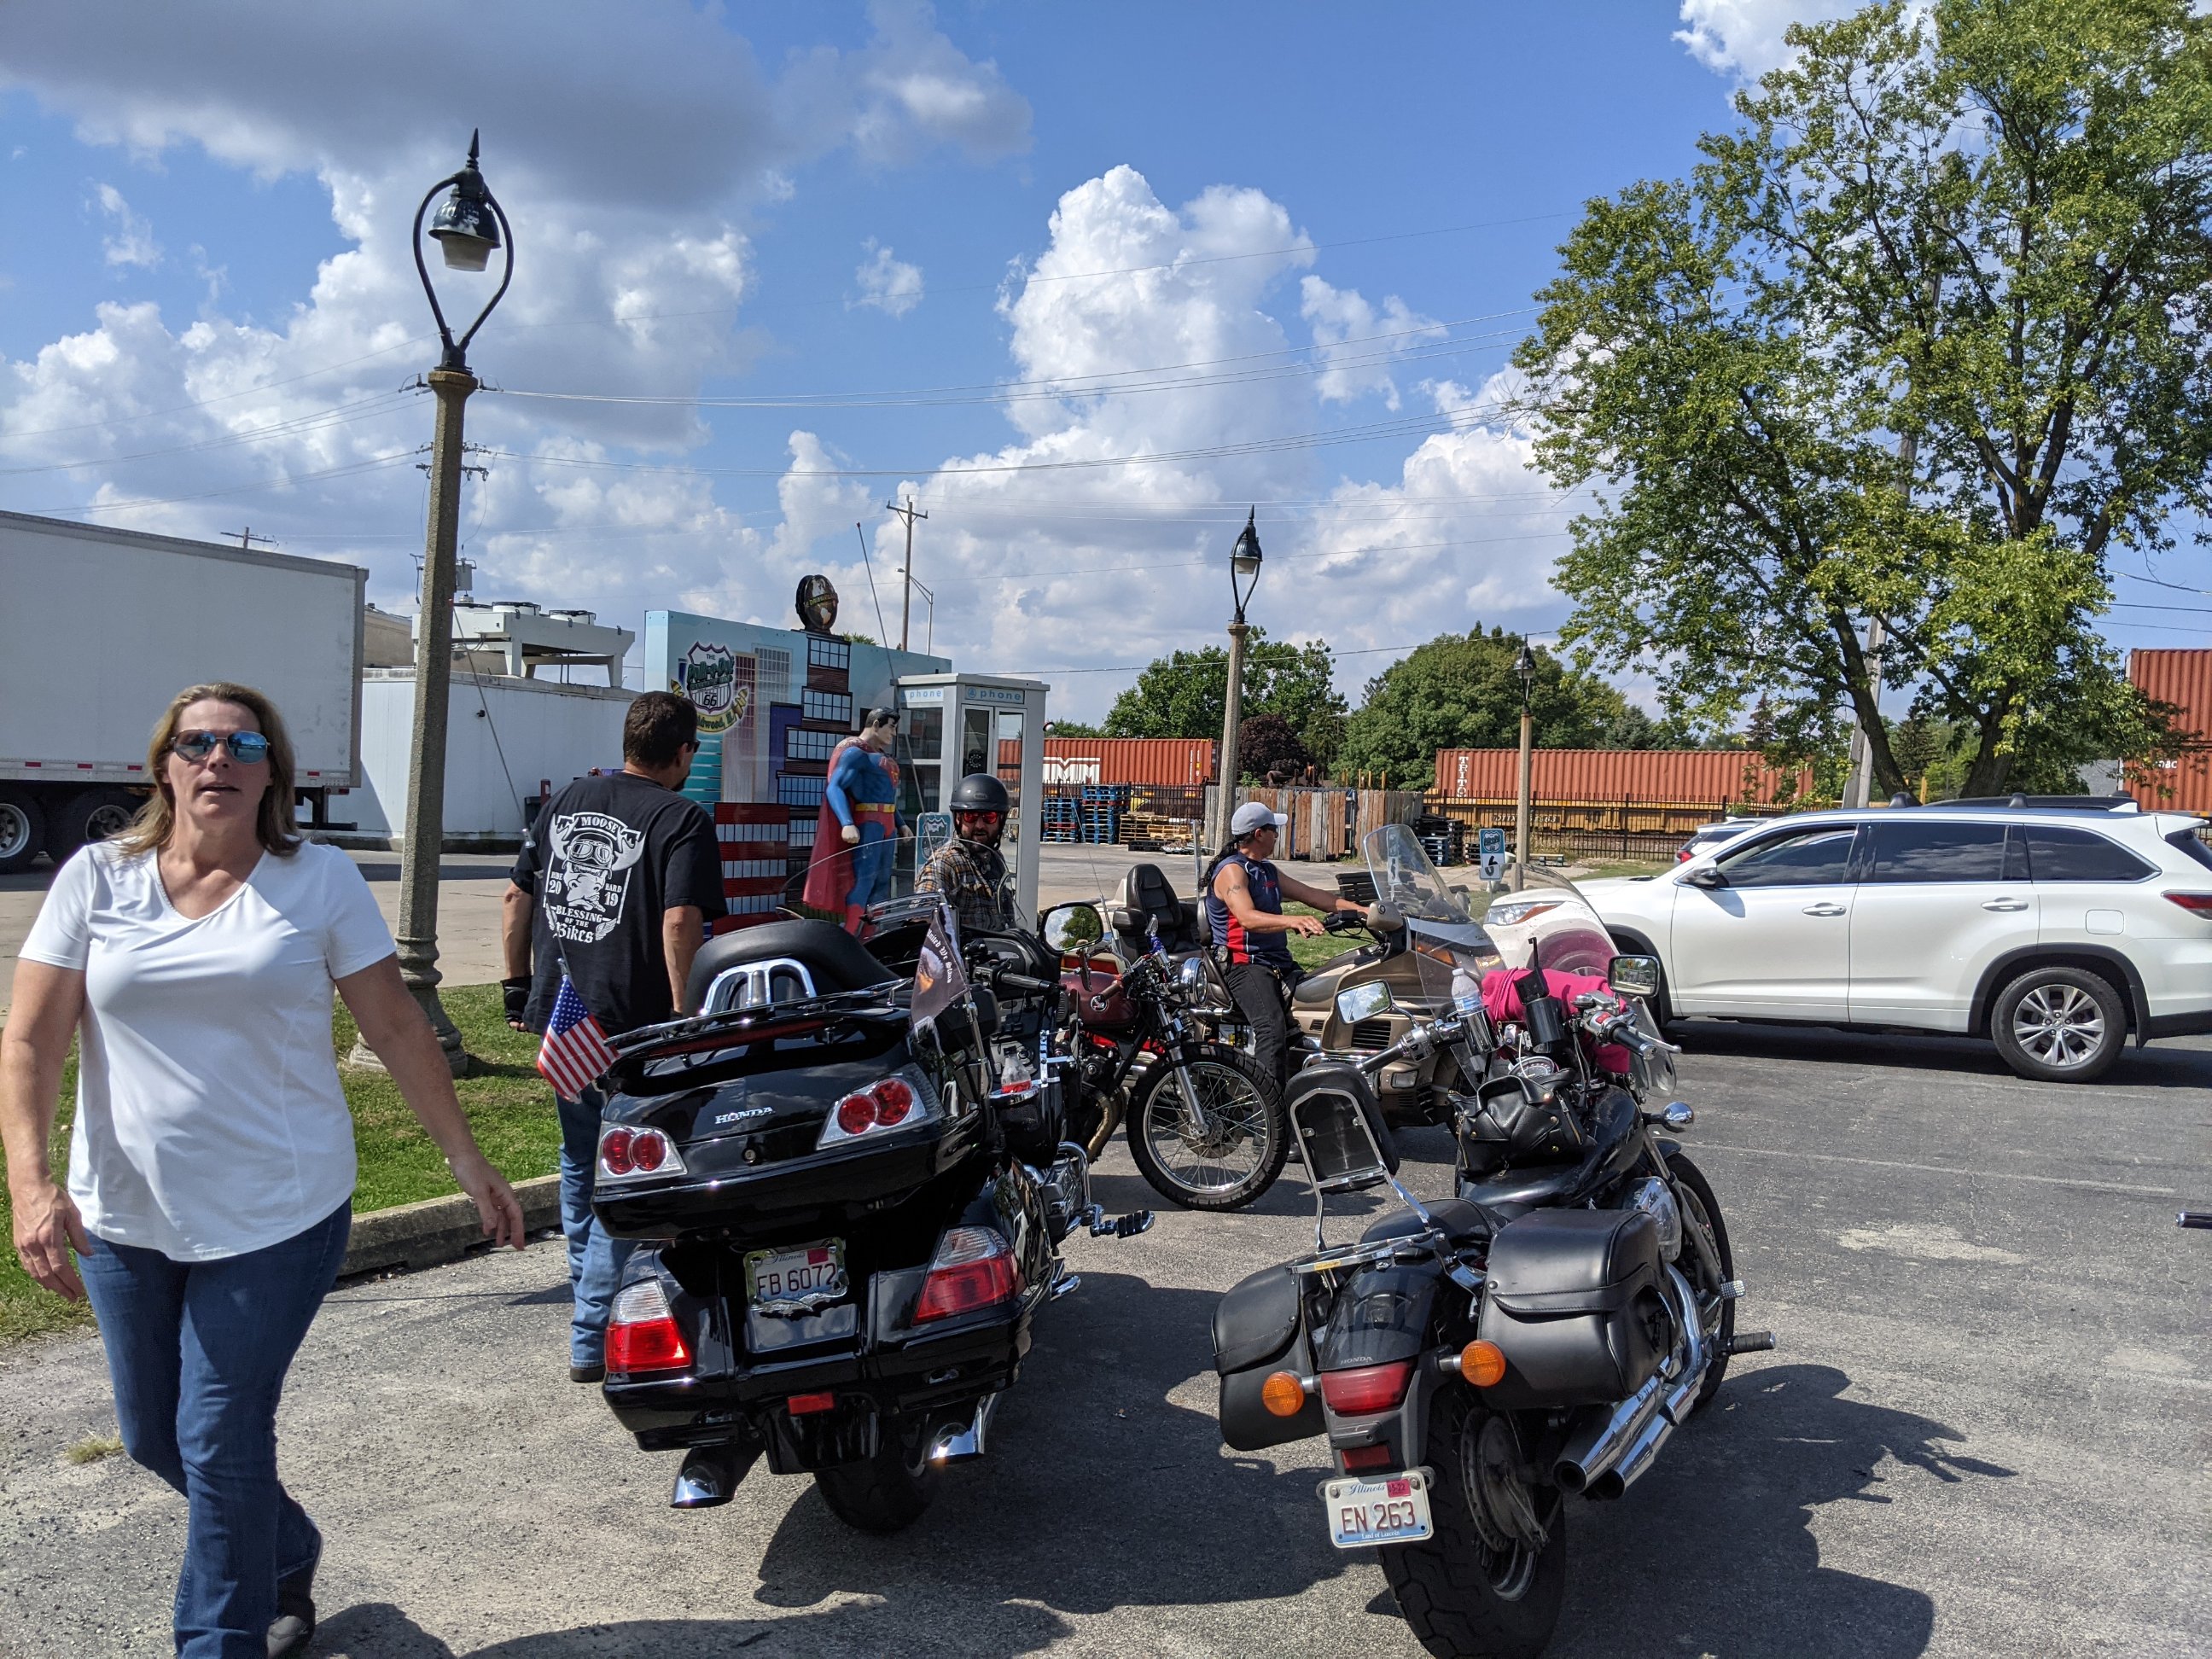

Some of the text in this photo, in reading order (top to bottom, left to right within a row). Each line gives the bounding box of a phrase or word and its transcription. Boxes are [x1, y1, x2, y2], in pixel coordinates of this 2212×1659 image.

[703, 694, 718, 707] 66
[910, 689, 941, 700] phone
[980, 690, 1022, 701] phone
[580, 816, 619, 834] MOOSE
[1485, 855, 1498, 876] 6
[548, 879, 562, 895] 20
[604, 882, 623, 894] HARD
[604, 892, 619, 907] 19
[556, 905, 603, 923] BLESSING
[575, 919, 590, 928] THE
[553, 922, 595, 944] Bikes
[927, 928, 941, 949] United
[939, 946, 948, 961] We
[714, 1106, 776, 1125] HONDA
[756, 1262, 836, 1296] FB 6072
[1341, 1356, 1373, 1365] HONDA
[1347, 1483, 1386, 1496] Illinois
[1341, 1500, 1416, 1534] EN 263
[1381, 1529, 1400, 1538] Lincoln
